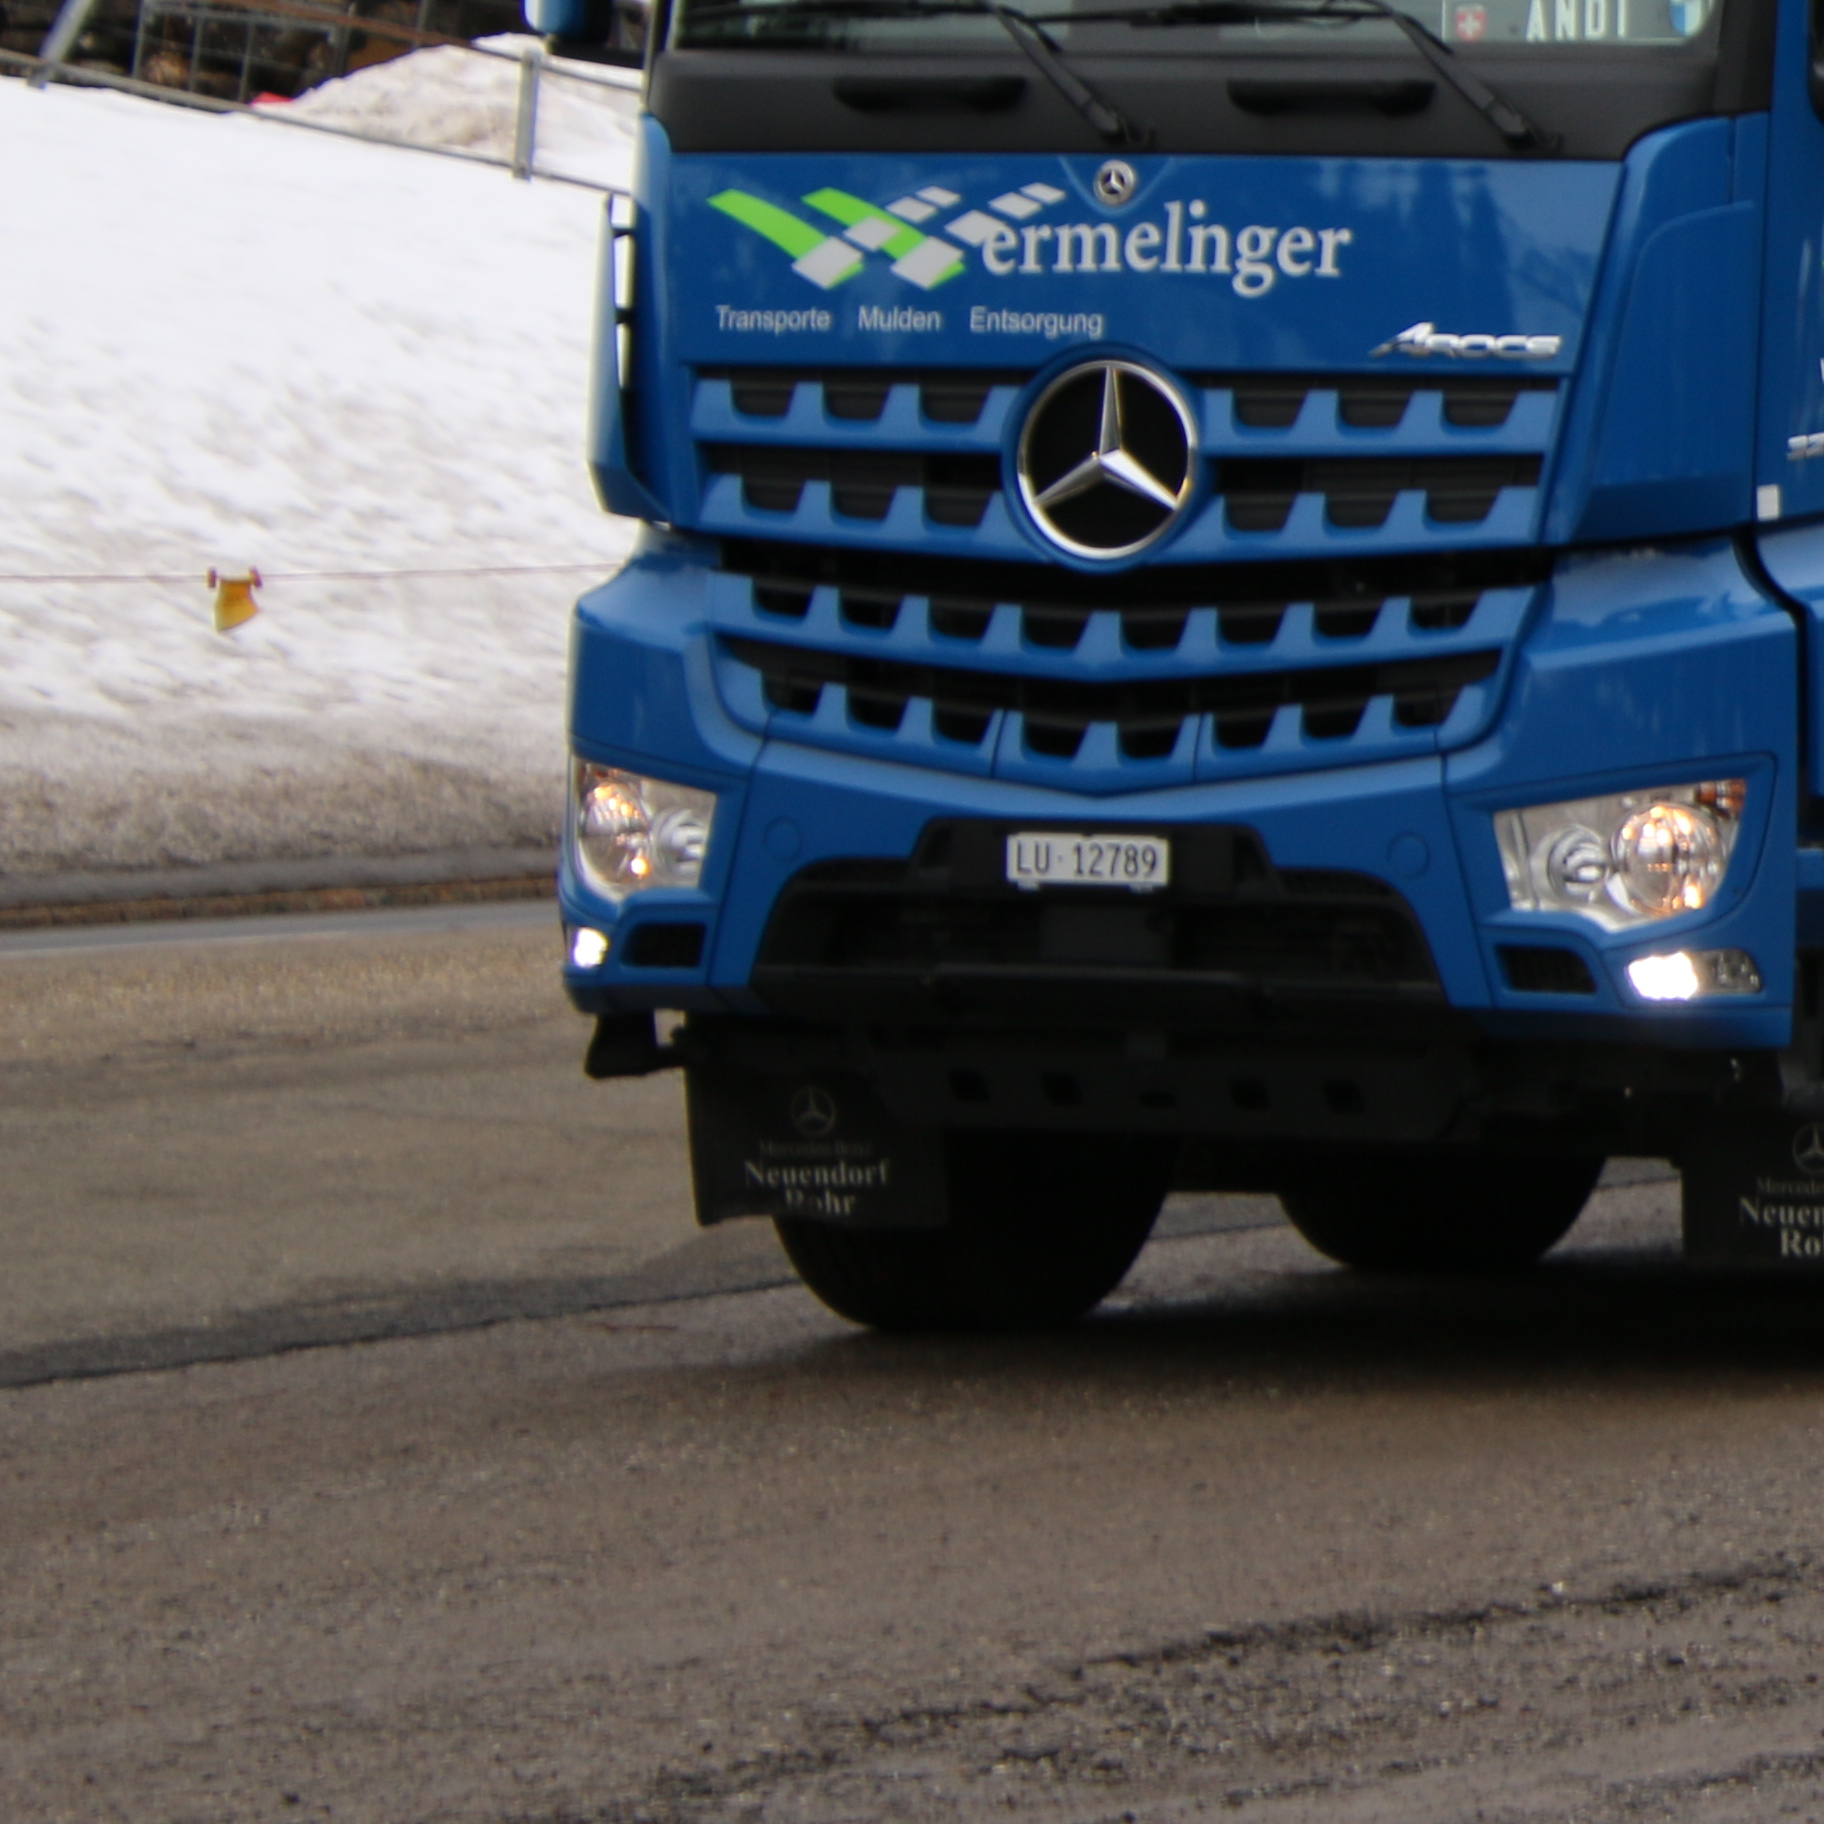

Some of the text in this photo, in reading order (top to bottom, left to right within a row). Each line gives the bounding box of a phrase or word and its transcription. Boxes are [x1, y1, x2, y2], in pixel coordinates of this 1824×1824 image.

[716, 305, 1103, 340] Transporte Mulden Entsorgung
[1073, 842, 1157, 877] 12789
[745, 1159, 891, 1186] Neuendorf
